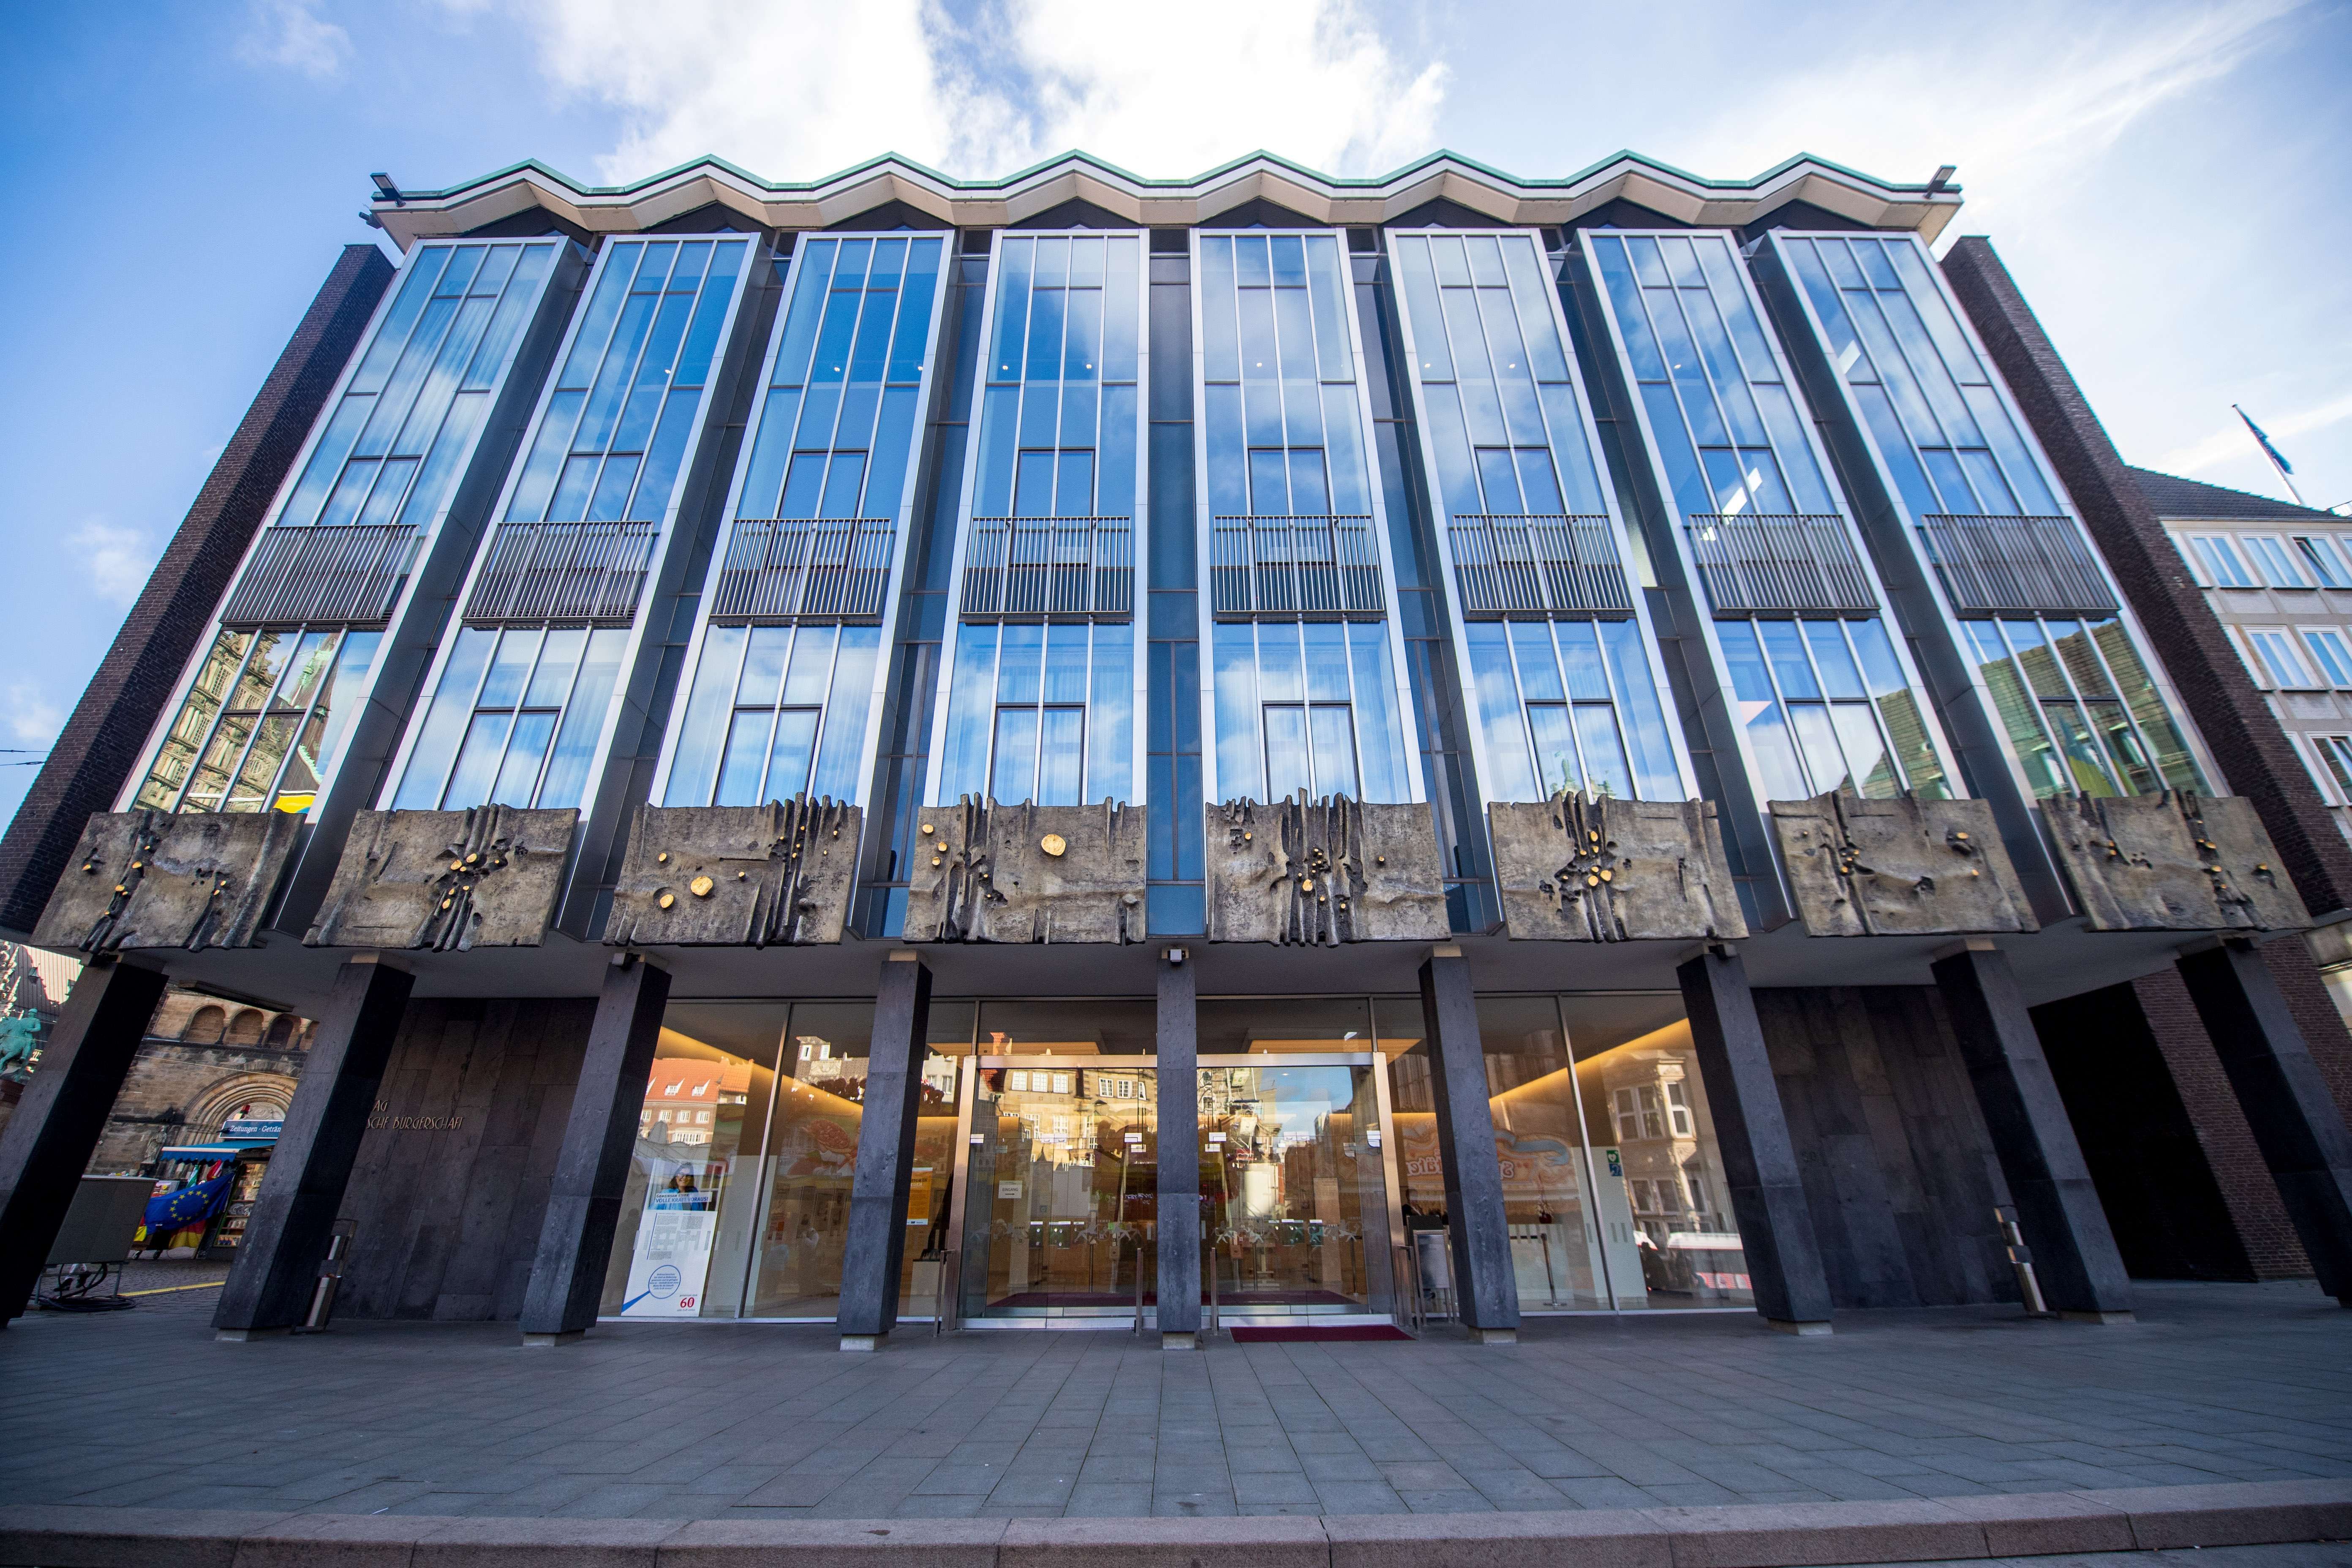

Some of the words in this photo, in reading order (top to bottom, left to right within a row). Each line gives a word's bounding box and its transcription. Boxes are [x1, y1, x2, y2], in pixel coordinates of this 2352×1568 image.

[392, 1114, 463, 1129] BÜRGERSCHAFT
[229, 1125, 257, 1133] Zeitungen
[680, 1297, 695, 1308] 60
